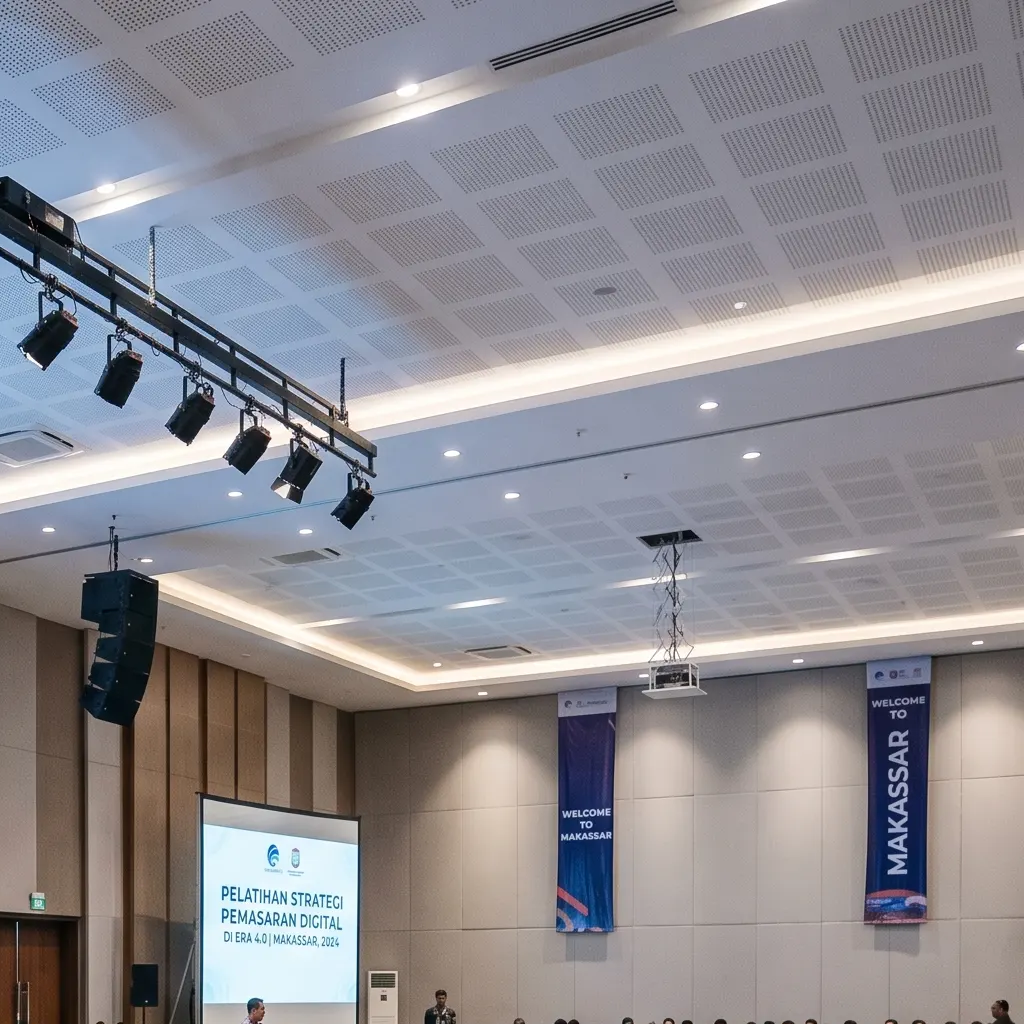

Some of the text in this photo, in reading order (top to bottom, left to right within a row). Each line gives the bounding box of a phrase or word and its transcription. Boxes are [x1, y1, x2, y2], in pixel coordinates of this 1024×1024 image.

[871, 695, 926, 708] WELCOME
[889, 709, 907, 720] TO
[887, 729, 909, 875] MAKASSAR
[562, 808, 611, 818] WELCOME
[579, 820, 593, 829] TO
[560, 832, 612, 841] MAKASSAR
[221, 885, 344, 910] PELATIHAN STRATEGI
[221, 908, 343, 931] PEMASARAN DIGITAL
[223, 930, 233, 943] DI
[235, 931, 252, 944] ERA
[254, 932, 267, 945] 4.0
[273, 933, 320, 948] MAKASSAR,
[321, 936, 340, 948] 2024
